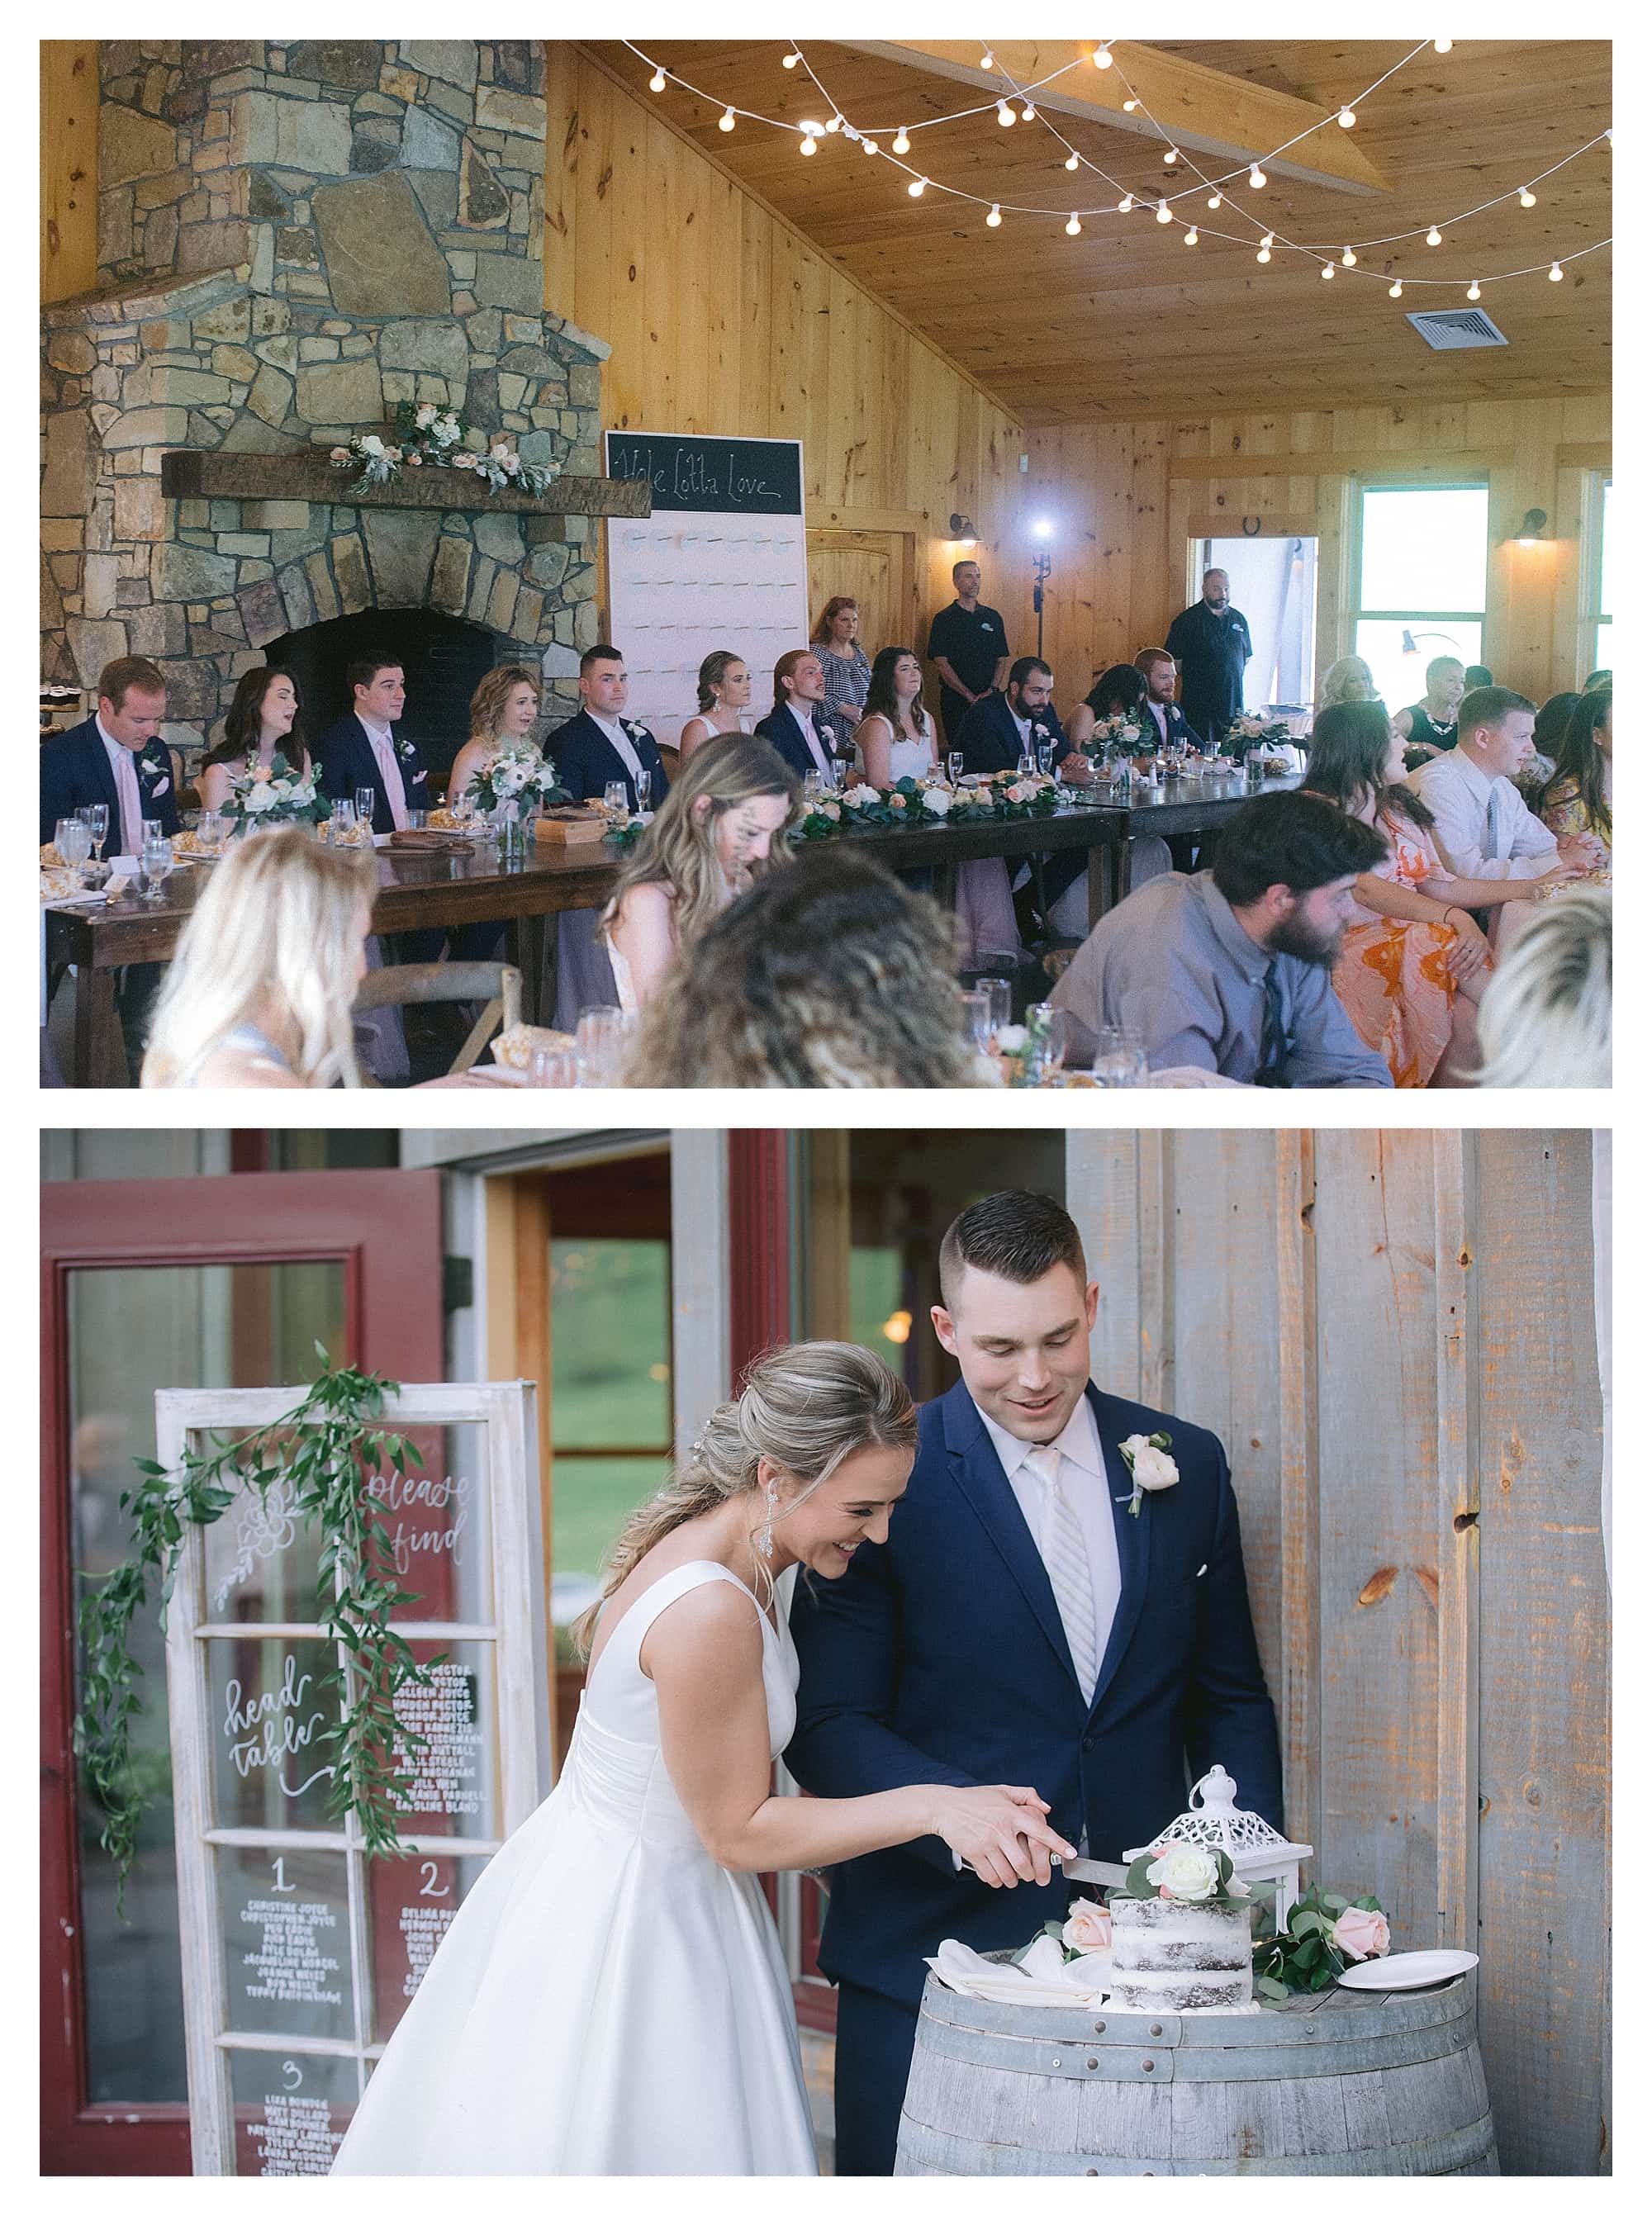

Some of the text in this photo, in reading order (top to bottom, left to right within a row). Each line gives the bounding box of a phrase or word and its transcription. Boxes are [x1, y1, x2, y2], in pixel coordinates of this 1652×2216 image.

[674, 448, 719, 501] Lotta
[728, 453, 781, 502] Love
[358, 1469, 474, 1514] please
[391, 1510, 468, 1574] find
[224, 1654, 312, 1737] head
[229, 1712, 325, 1777] table
[271, 1857, 296, 1891] 1
[420, 1862, 450, 1897] 2
[282, 2060, 302, 2090] 3
